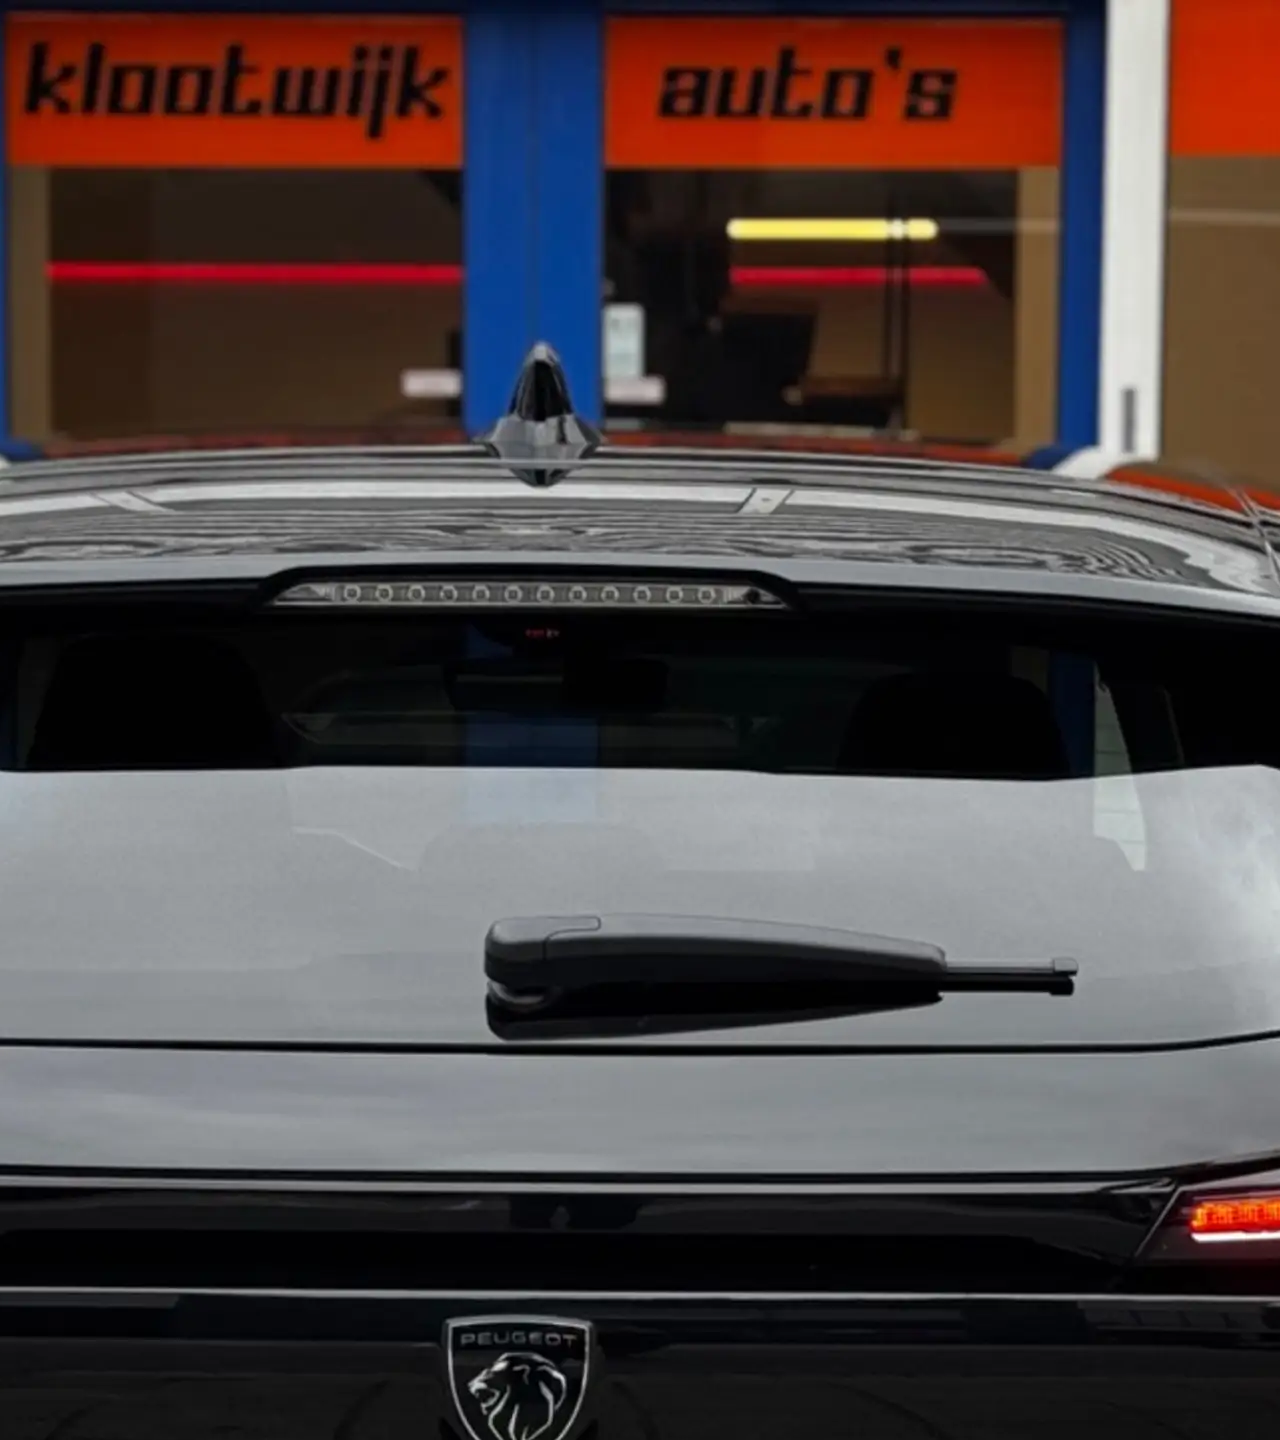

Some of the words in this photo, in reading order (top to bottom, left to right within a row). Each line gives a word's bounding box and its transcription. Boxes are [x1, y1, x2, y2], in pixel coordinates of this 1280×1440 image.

[24, 41, 450, 139] klootwijk
[657, 44, 958, 121] auto's
[460, 1331, 577, 1347] PEUGEOT
